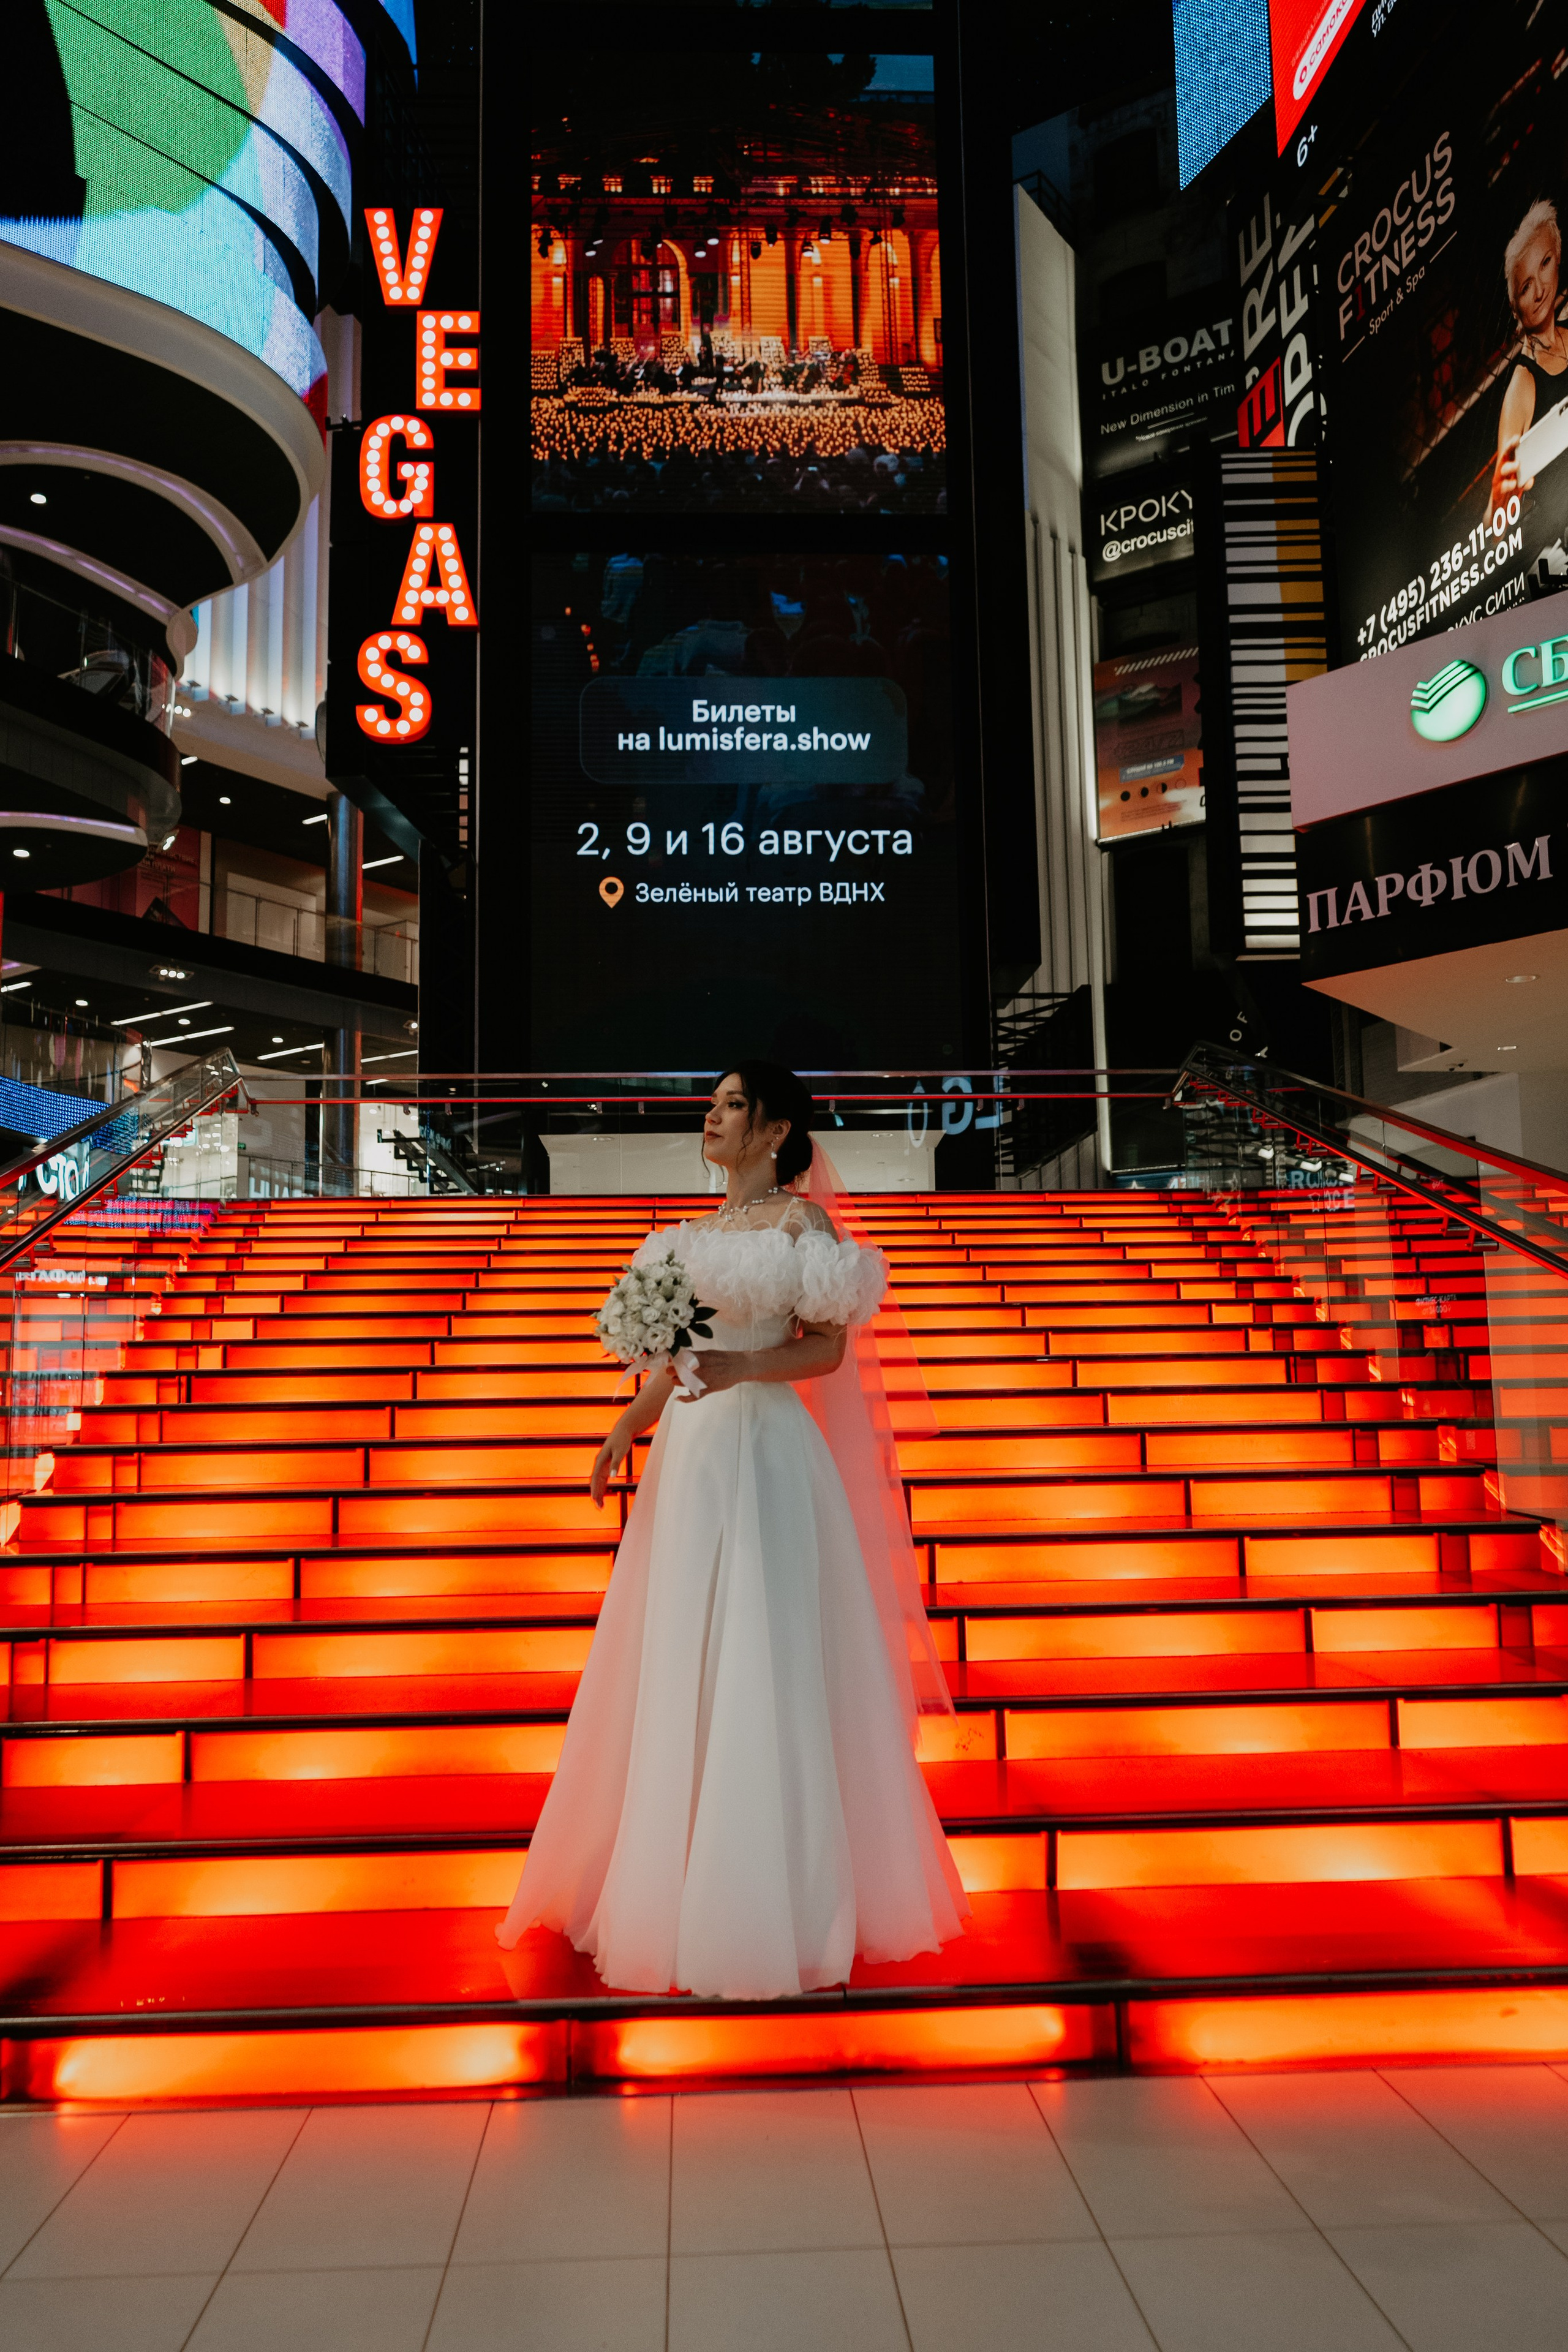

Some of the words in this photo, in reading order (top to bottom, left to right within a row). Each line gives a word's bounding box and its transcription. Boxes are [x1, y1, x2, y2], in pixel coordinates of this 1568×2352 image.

[1338, 130, 1452, 295] CROCUS
[1369, 303, 1394, 336] Sport
[1396, 288, 1404, 301] &
[1406, 265, 1426, 293] Spa
[1101, 318, 1233, 386] U-BOAT
[1100, 419, 1127, 435] New
[1130, 396, 1194, 426] Dimension
[1197, 390, 1209, 402] in
[1102, 379, 1149, 401] ITALO
[355, 207, 481, 745] VEGAS
[1357, 614, 1376, 647] +7
[1380, 575, 1426, 634] (495)
[1429, 495, 1521, 593] 236-11-00
[1485, 571, 1525, 616] СИТИ
[692, 699, 796, 723] Билеты
[617, 732, 650, 752] на
[658, 727, 871, 752] lumisfera.show
[576, 822, 611, 860] 2,
[625, 822, 651, 856] 9
[666, 830, 688, 856] и
[701, 822, 745, 856] 16
[758, 828, 913, 862] августа
[635, 879, 739, 903] Зелёный
[745, 886, 812, 907] театр
[819, 882, 885, 905] ВДНХ
[1306, 834, 1554, 934] ПАРФЮМ
